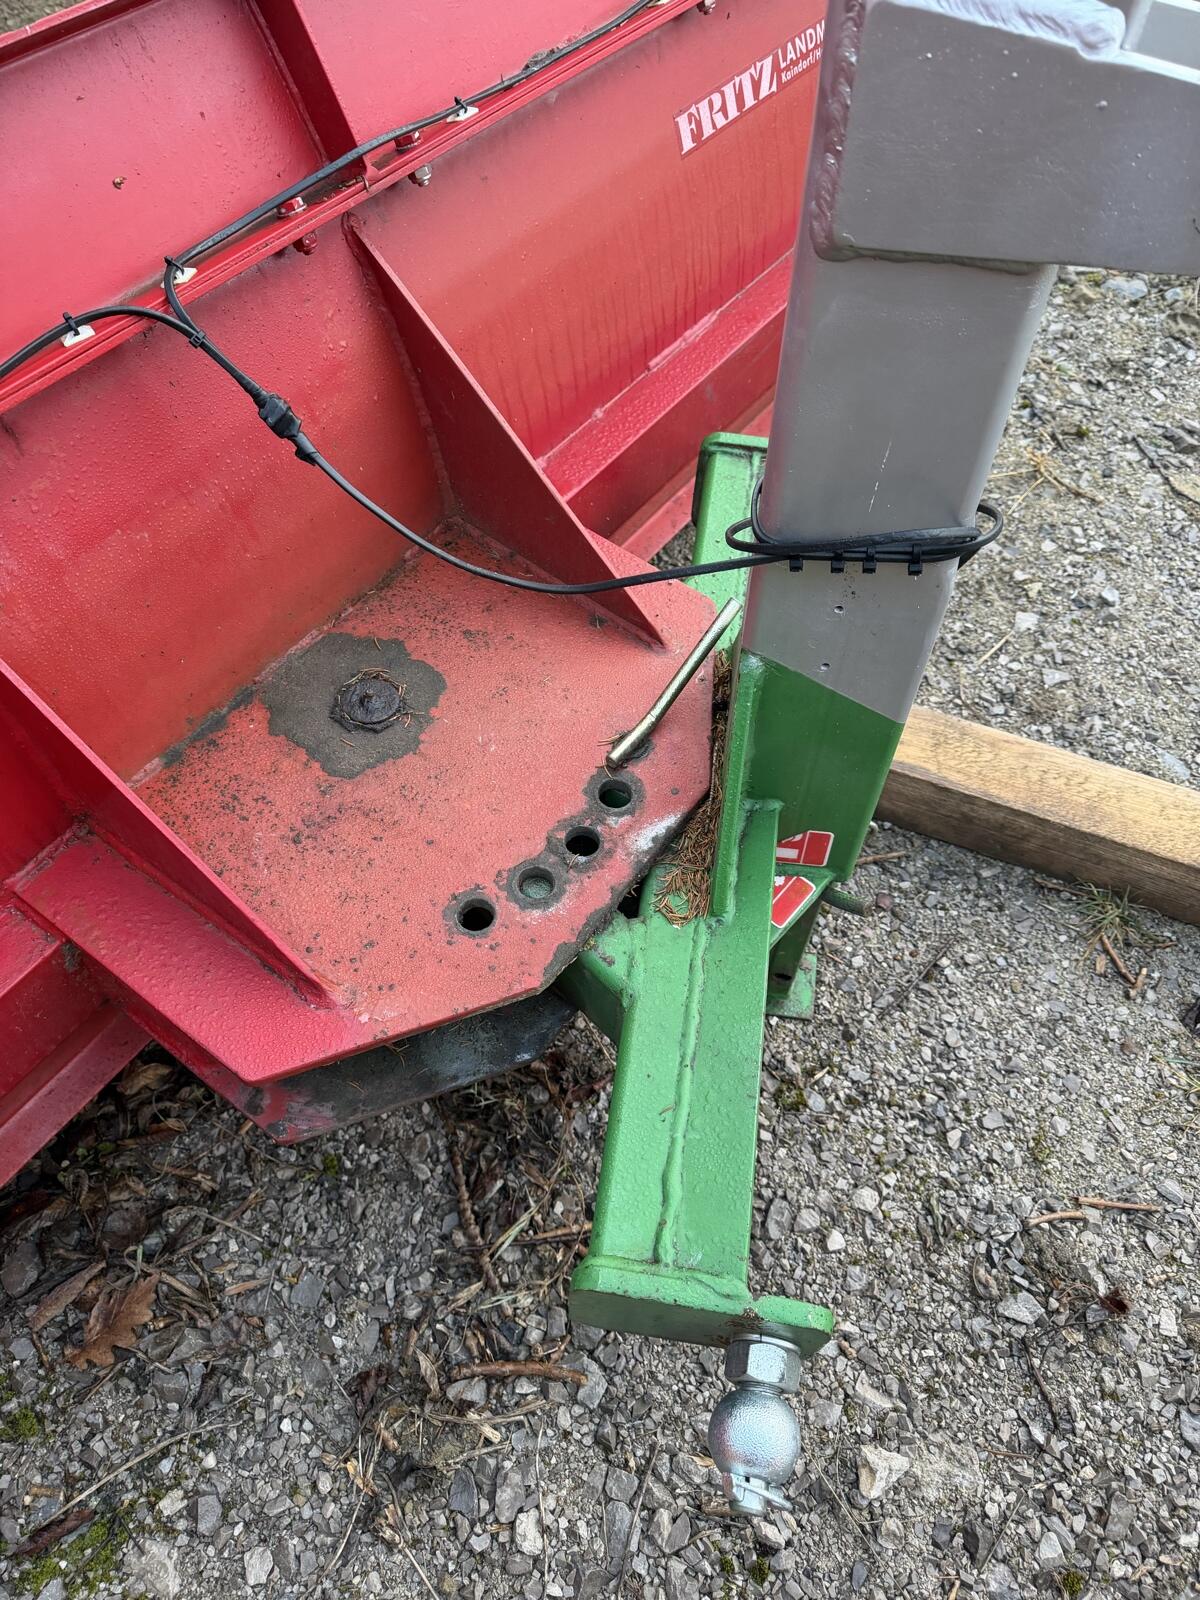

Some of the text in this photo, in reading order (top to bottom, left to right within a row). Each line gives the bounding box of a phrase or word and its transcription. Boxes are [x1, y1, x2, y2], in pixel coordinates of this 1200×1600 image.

[778, 19, 825, 69] LANDM
[780, 47, 822, 84] Kaindorf/H
[674, 55, 777, 155] FRITZ
